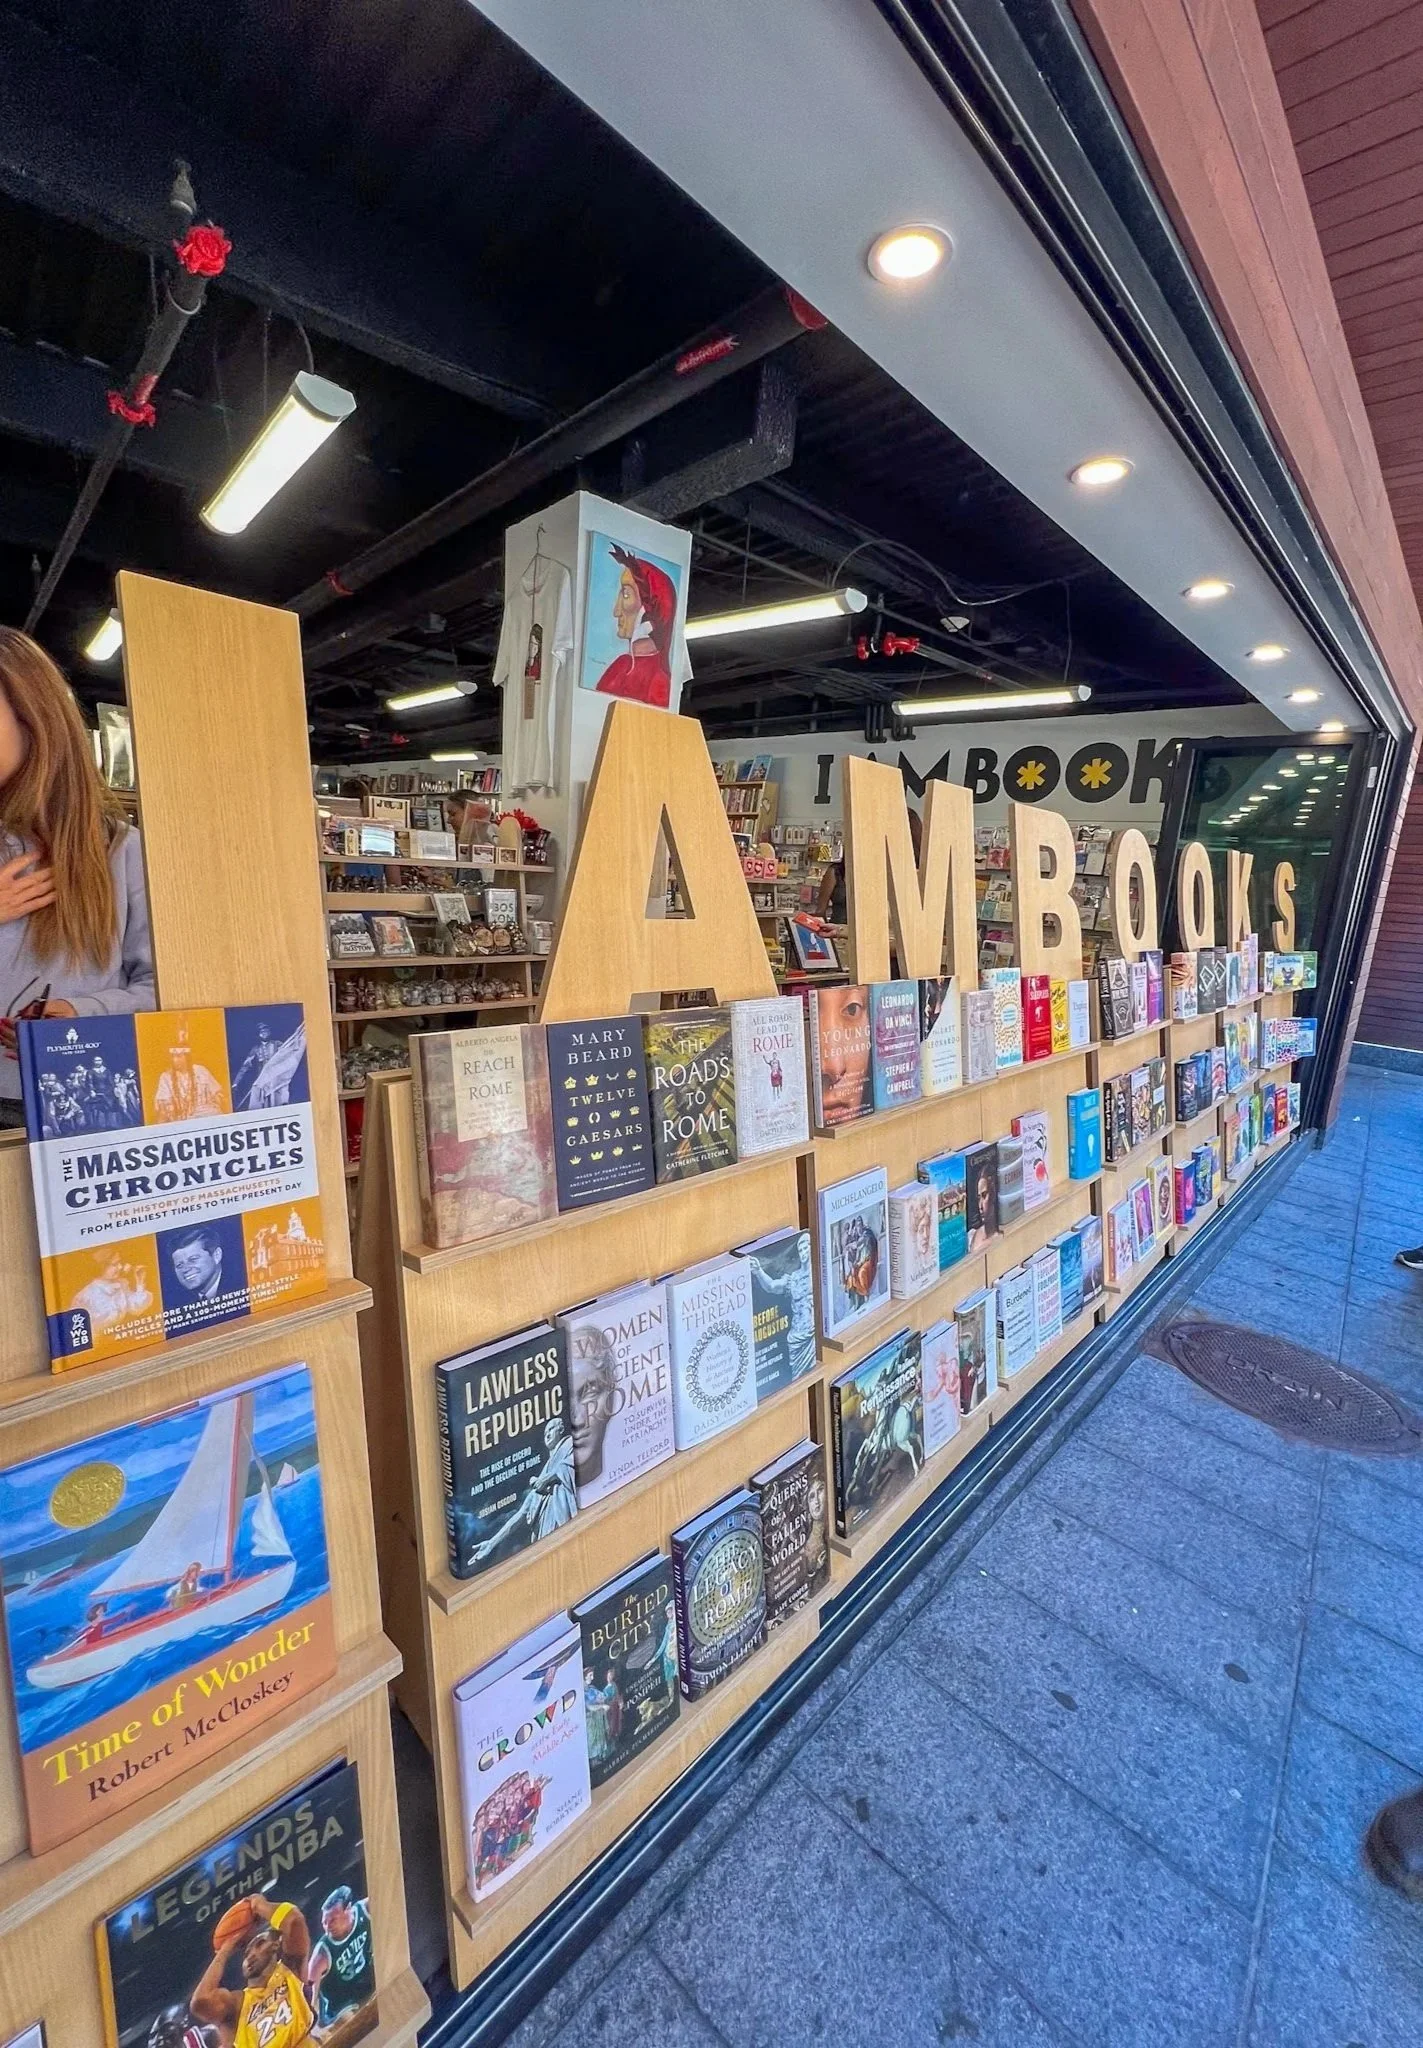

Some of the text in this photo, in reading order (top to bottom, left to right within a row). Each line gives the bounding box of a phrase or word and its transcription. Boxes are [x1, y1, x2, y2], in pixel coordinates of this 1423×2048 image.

[814, 740, 1188, 804] I M BOOK
[542, 700, 978, 1022] AM
[1009, 802, 1296, 980] BOOKS
[881, 994, 914, 1009] LEONARDO
[752, 1014, 793, 1026] ALL ROADS
[756, 1023, 789, 1035] LEAD TO
[823, 1025, 871, 1044] YOUNG
[885, 1014, 912, 1030] DA VINCI
[46, 1044, 84, 1053] PLYMOUTH
[455, 1034, 518, 1048] ALBERTO ANGELA
[572, 1029, 626, 1046] MARY
[678, 1038, 706, 1055] THE
[752, 1033, 794, 1053] ROME
[824, 1042, 872, 1058] LEONARDO
[927, 1036, 959, 1049] LEONARDO
[463, 1056, 515, 1075] REACH
[567, 1046, 632, 1066] BEARD
[885, 1063, 909, 1077] STEPHEN
[654, 1056, 730, 1090] ROADS
[886, 1080, 914, 1095] CAMPBELL
[469, 1082, 513, 1101] ROME
[569, 1087, 636, 1108] TWELVE
[686, 1090, 706, 1107] TO
[566, 1123, 643, 1147] CAESARS
[662, 1108, 731, 1143] ROME
[78, 1121, 301, 1180] MASSACHUSETTS
[666, 1149, 729, 1170] CATHERINE FLETCHER
[63, 1158, 72, 1182] THE
[66, 1147, 304, 1208] CHRONICLES
[80, 1182, 302, 1236] FROM EARLIEST TIMES TO THE PRESENT DAY
[107, 1177, 281, 1220] THE HISTORY OF MASSACHUSETTS
[831, 1180, 884, 1212] MICHELANGELO
[681, 1276, 747, 1316] MISSING
[706, 1275, 722, 1286] THE
[1006, 1285, 1032, 1308] Burdened
[103, 1316, 153, 1335] INCLUDES
[155, 1308, 181, 1319] MORE
[183, 1299, 208, 1312] THAN
[222, 1273, 300, 1300] NEWSPAPER-STYLE
[114, 1322, 161, 1340] ARTICLES
[163, 1315, 183, 1327] AND
[194, 1297, 250, 1318] 100-MOMENT
[252, 1283, 293, 1299] TIMELINE!
[682, 1293, 747, 1332] THREAD
[753, 1305, 779, 1328] BEFORE
[575, 1304, 662, 1358] WOMEN
[617, 1344, 632, 1359] OF
[896, 1355, 917, 1374] Italian
[465, 1347, 559, 1415] LAWLESS
[582, 1343, 665, 1397] ANCIENT
[436, 1376, 449, 1435] LAWLESS
[584, 1364, 667, 1429] ROME
[860, 1365, 917, 1418] Renaissance
[464, 1384, 563, 1457] REPUBLIC
[624, 1398, 667, 1425] TO SURVIVE
[624, 1407, 668, 1436] UNDER THE
[693, 1418, 720, 1435] DAISY
[621, 1417, 668, 1449] PATRIARCHY
[471, 1454, 541, 1496] AND THE DECLINE OF ROME
[479, 1446, 532, 1479] THE RISE OF CICERO
[608, 1459, 635, 1480] LYNDA
[636, 1438, 670, 1464] TELFORD
[770, 1474, 808, 1511] QUEENS
[771, 1514, 781, 1527] OF
[771, 1512, 807, 1547] FALLEN
[714, 1542, 739, 1567] THE
[771, 1533, 806, 1567] WORLD
[693, 1542, 760, 1604] LEGACY
[623, 1593, 640, 1608] The
[703, 1579, 754, 1630] ROME
[591, 1584, 669, 1651] BURIED
[607, 1614, 656, 1660] CITY
[42, 1621, 315, 1786] Time of Wonder
[626, 1676, 663, 1713] POMPEII
[88, 1670, 295, 1802] Robert McCloskey
[476, 1726, 504, 1750] THE
[478, 1689, 577, 1771] CROWD
[130, 1799, 315, 1944] LEGENDS
[196, 1815, 344, 1923] OF THE NBA
[335, 1930, 368, 1972] CELTICS
[256, 2000, 292, 2047] 24
